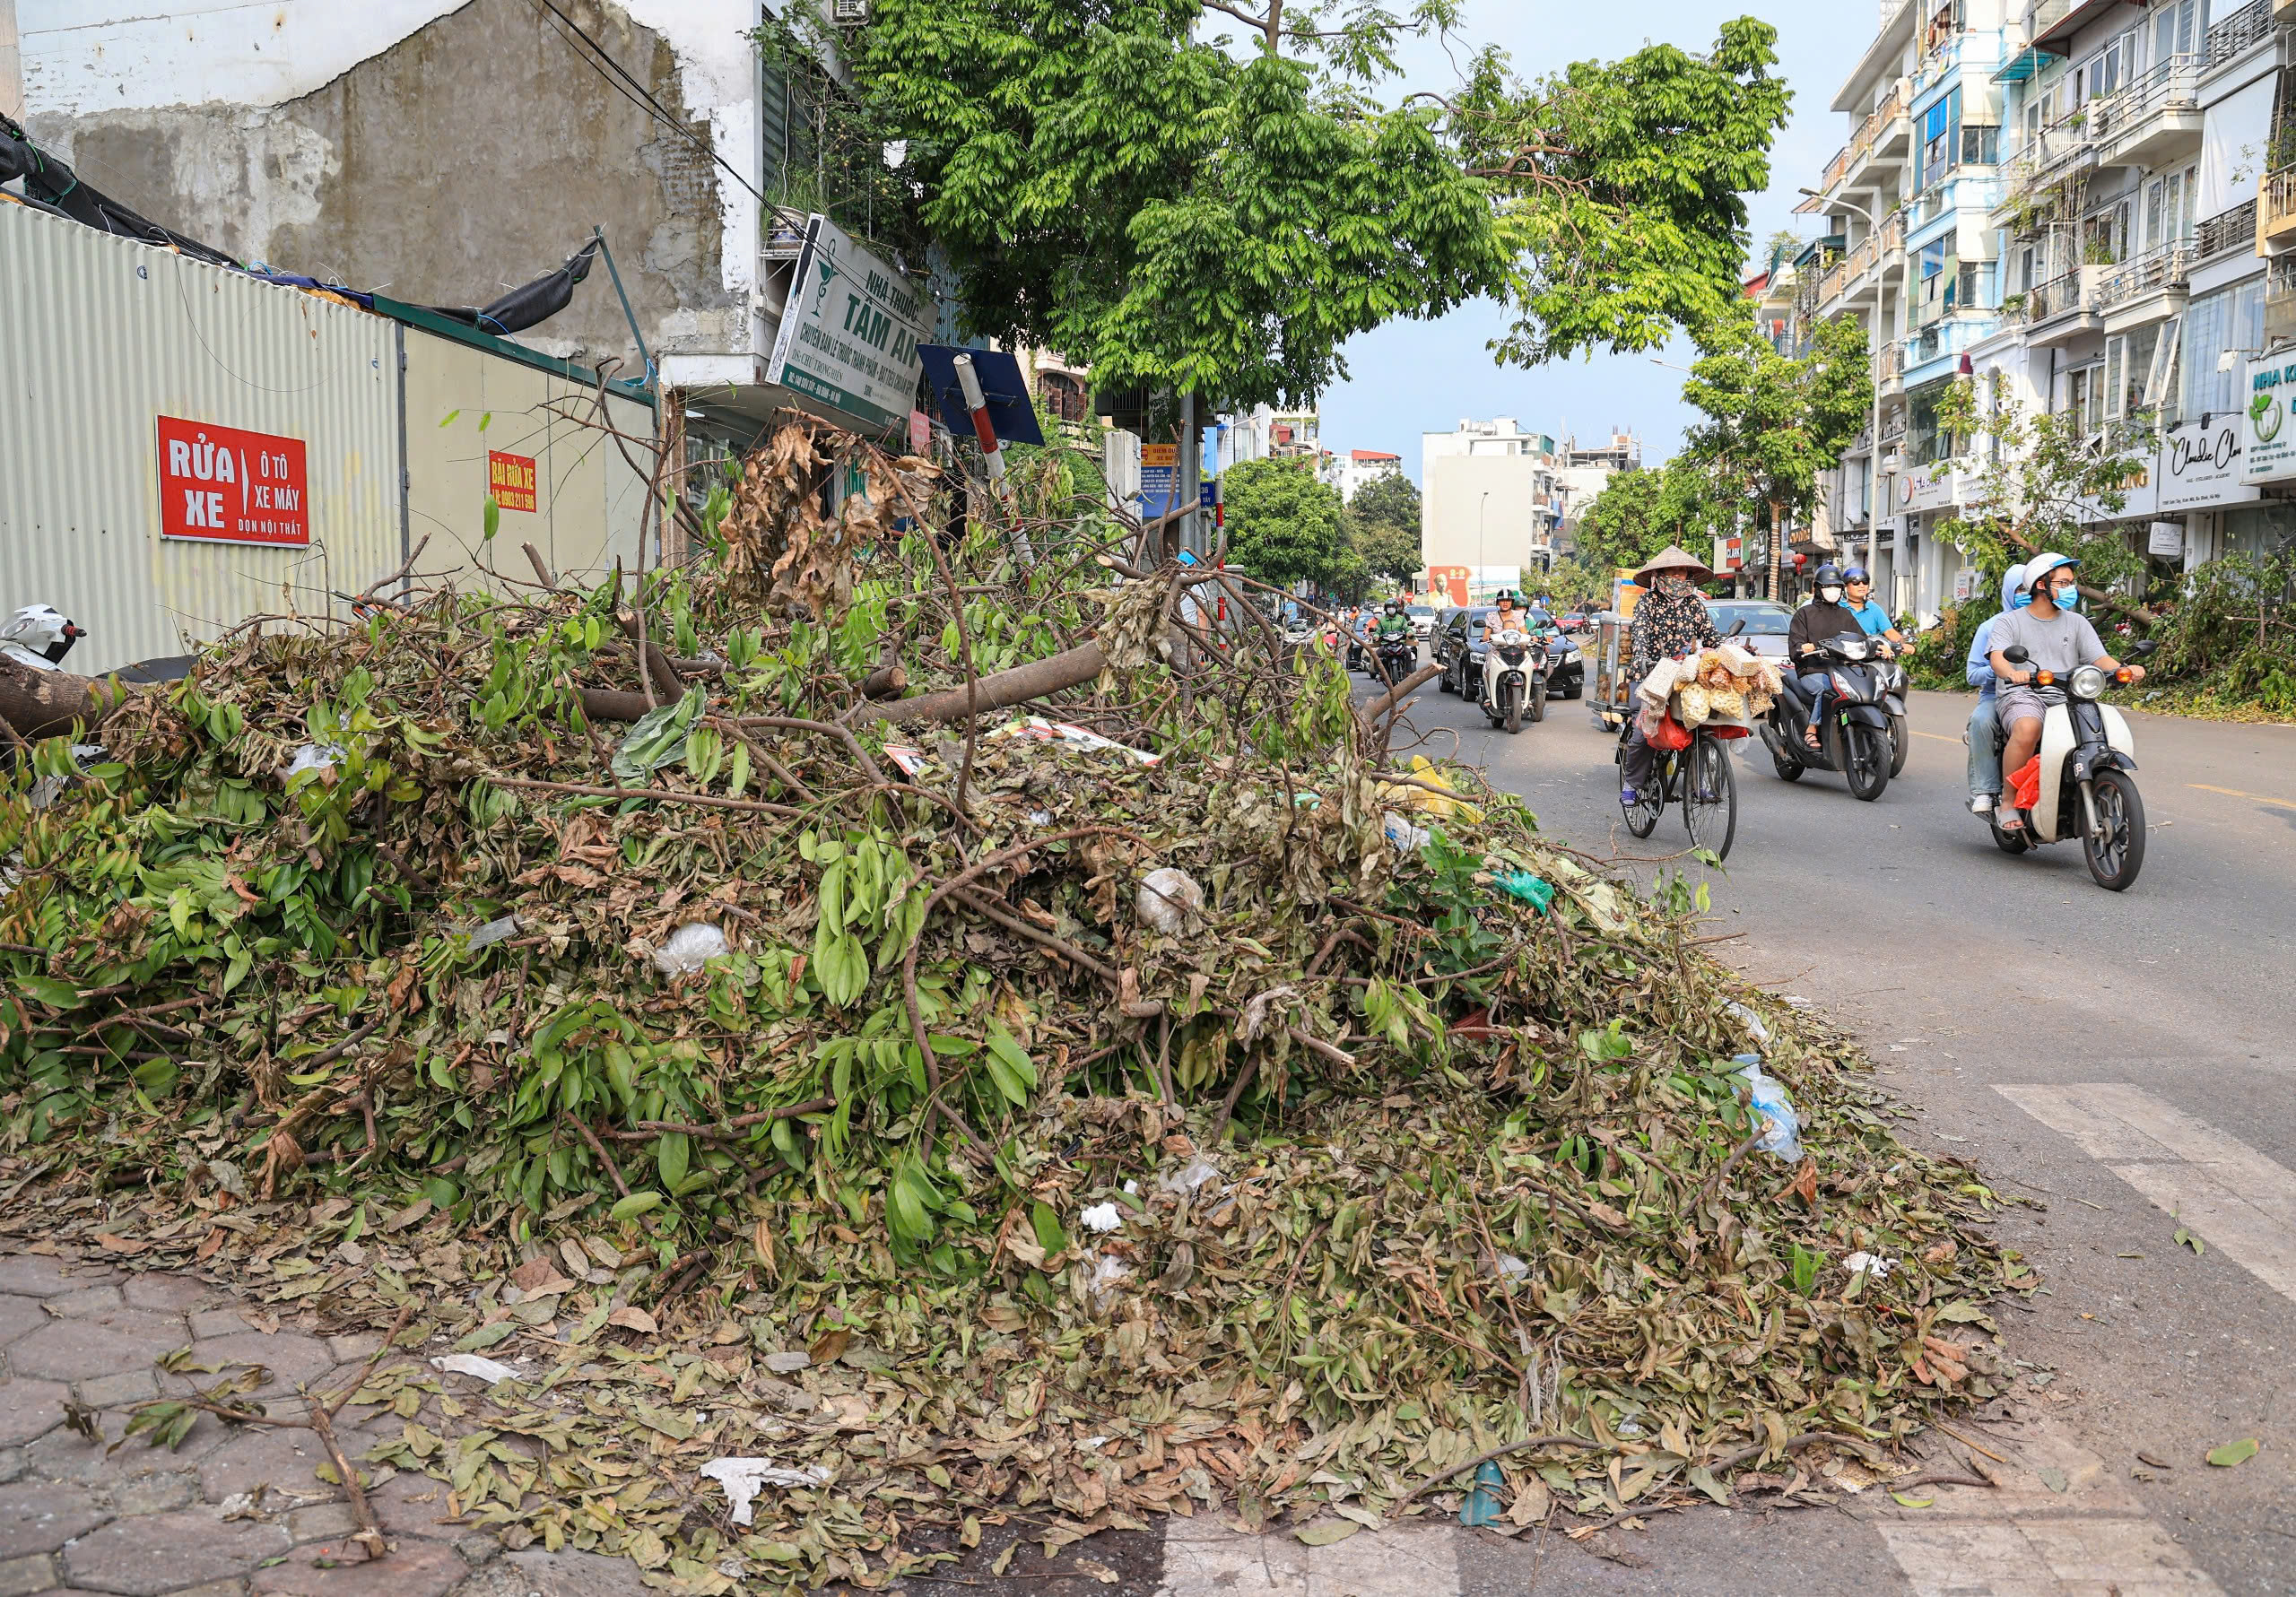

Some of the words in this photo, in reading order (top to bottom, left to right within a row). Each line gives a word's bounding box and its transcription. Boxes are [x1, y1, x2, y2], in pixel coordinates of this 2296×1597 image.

[865, 270, 890, 302] NHÀ
[890, 286, 919, 323] THUỐC
[800, 322, 823, 349] CHUYÊN
[820, 330, 833, 354] BÁN
[836, 341, 853, 365] THUỐC
[843, 293, 892, 352] TÂM
[891, 328, 921, 369] AN
[2253, 369, 2283, 391] NHA
[169, 432, 235, 483] RỬA
[260, 451, 268, 478] Ô
[272, 453, 288, 480] TÔ
[491, 458, 506, 485] BÃI
[506, 457, 523, 489] RỬA
[523, 466, 535, 490] XE
[184, 489, 225, 528] XE
[255, 484, 271, 508] XE
[274, 484, 300, 511] MÁY
[238, 518, 257, 534] DỌN
[260, 519, 277, 535] NỘI
